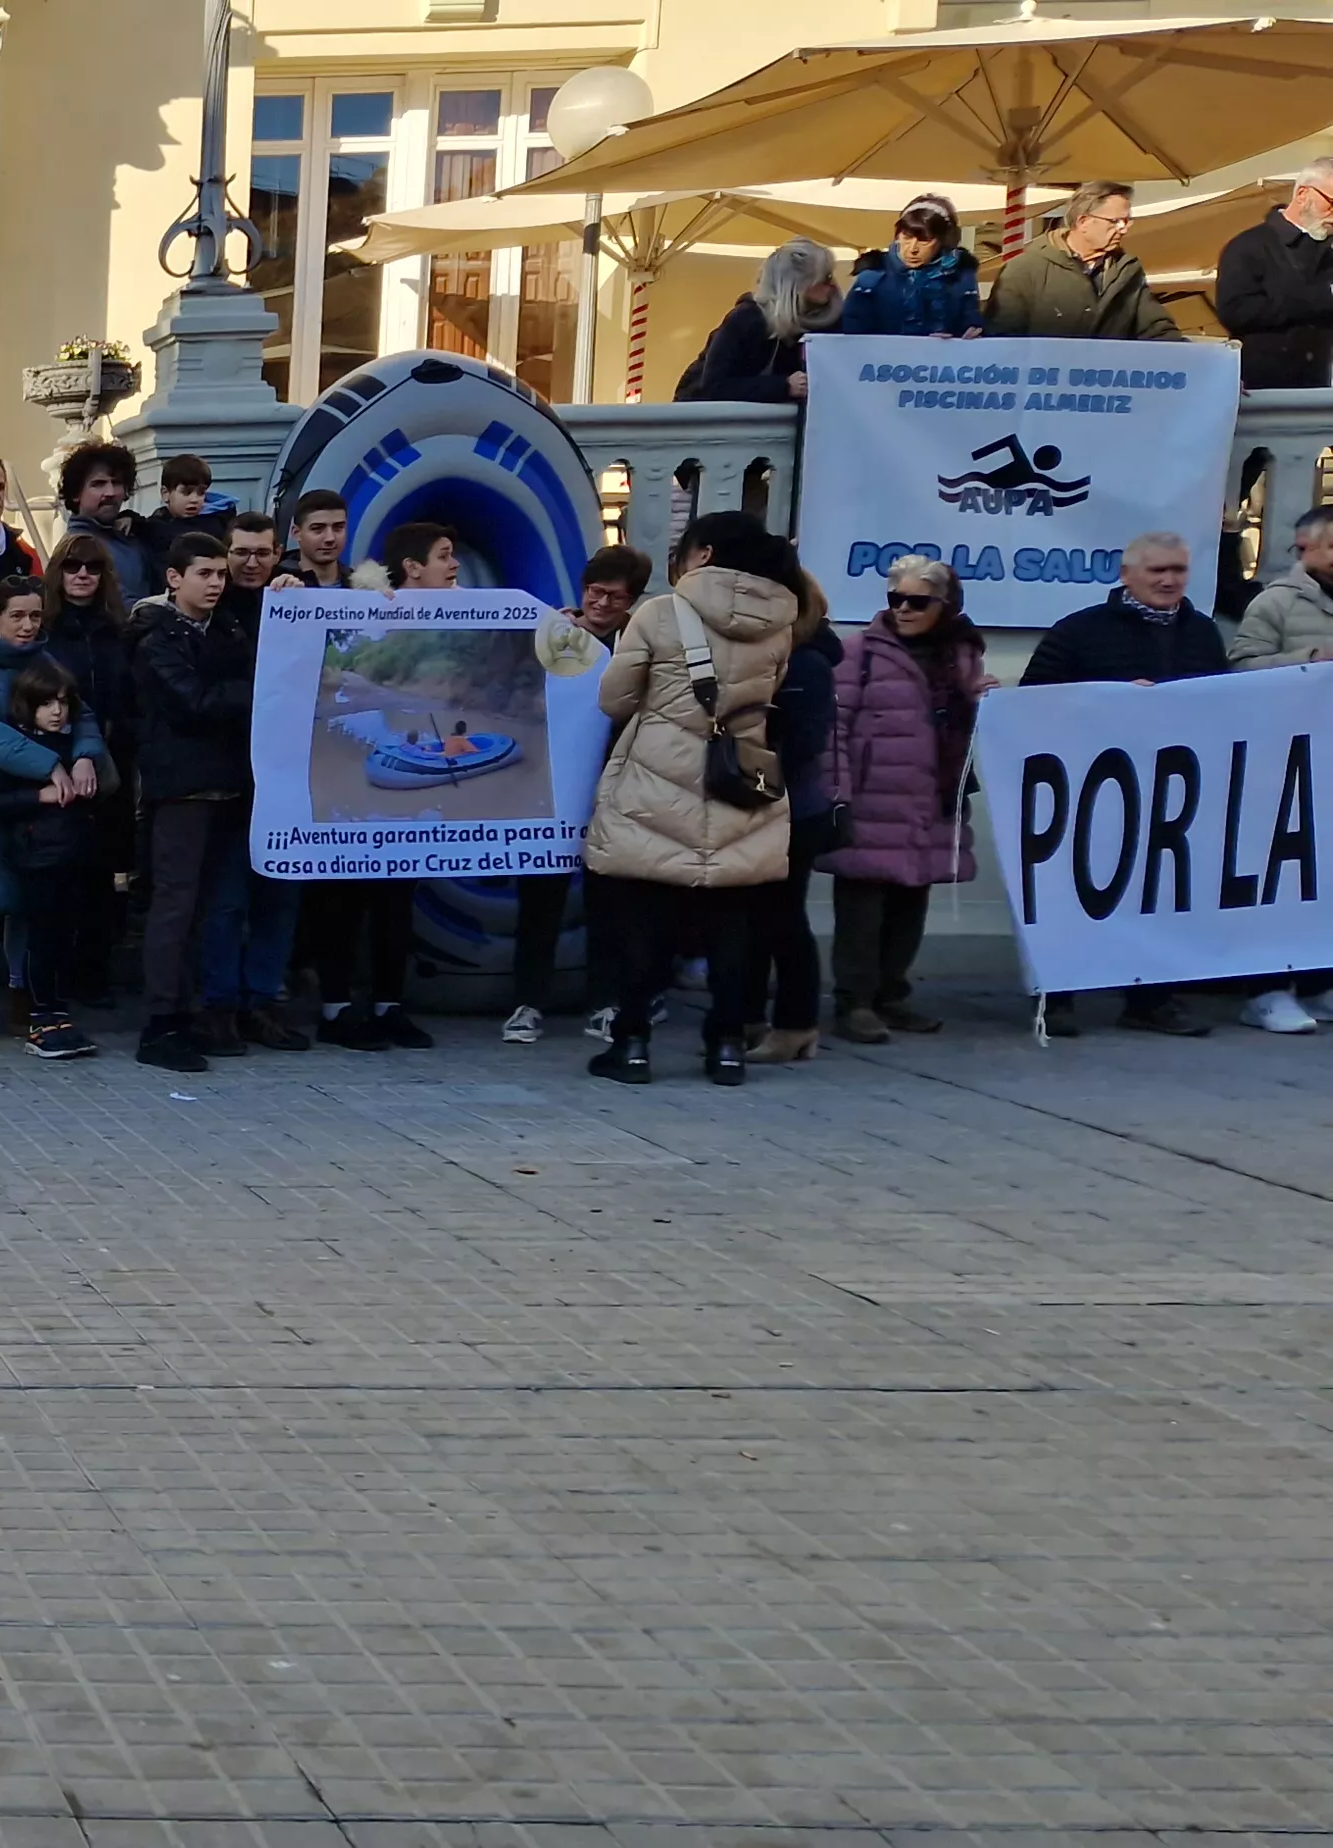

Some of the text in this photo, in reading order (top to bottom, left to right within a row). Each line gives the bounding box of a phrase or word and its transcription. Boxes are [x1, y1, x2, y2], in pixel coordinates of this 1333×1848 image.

[858, 362, 1187, 390] ASOCIACIÓN DE USUARIOS
[898, 390, 1133, 414] PISCINAS ALMERIZ
[958, 487, 1054, 517] AUPA
[951, 544, 1005, 581] LA
[1013, 548, 1124, 585] SALU
[269, 605, 538, 623] Mejor Destino Mundial de Aventura 2025
[373, 824, 498, 849] garantizada
[504, 825, 555, 845] para
[560, 820, 576, 839] ir
[1020, 733, 1318, 925] POR LA
[264, 860, 313, 874] casa
[317, 860, 328, 873] a
[330, 854, 381, 873] diario
[387, 859, 420, 876] por
[425, 853, 472, 872] Cruz
[478, 851, 513, 870] del
